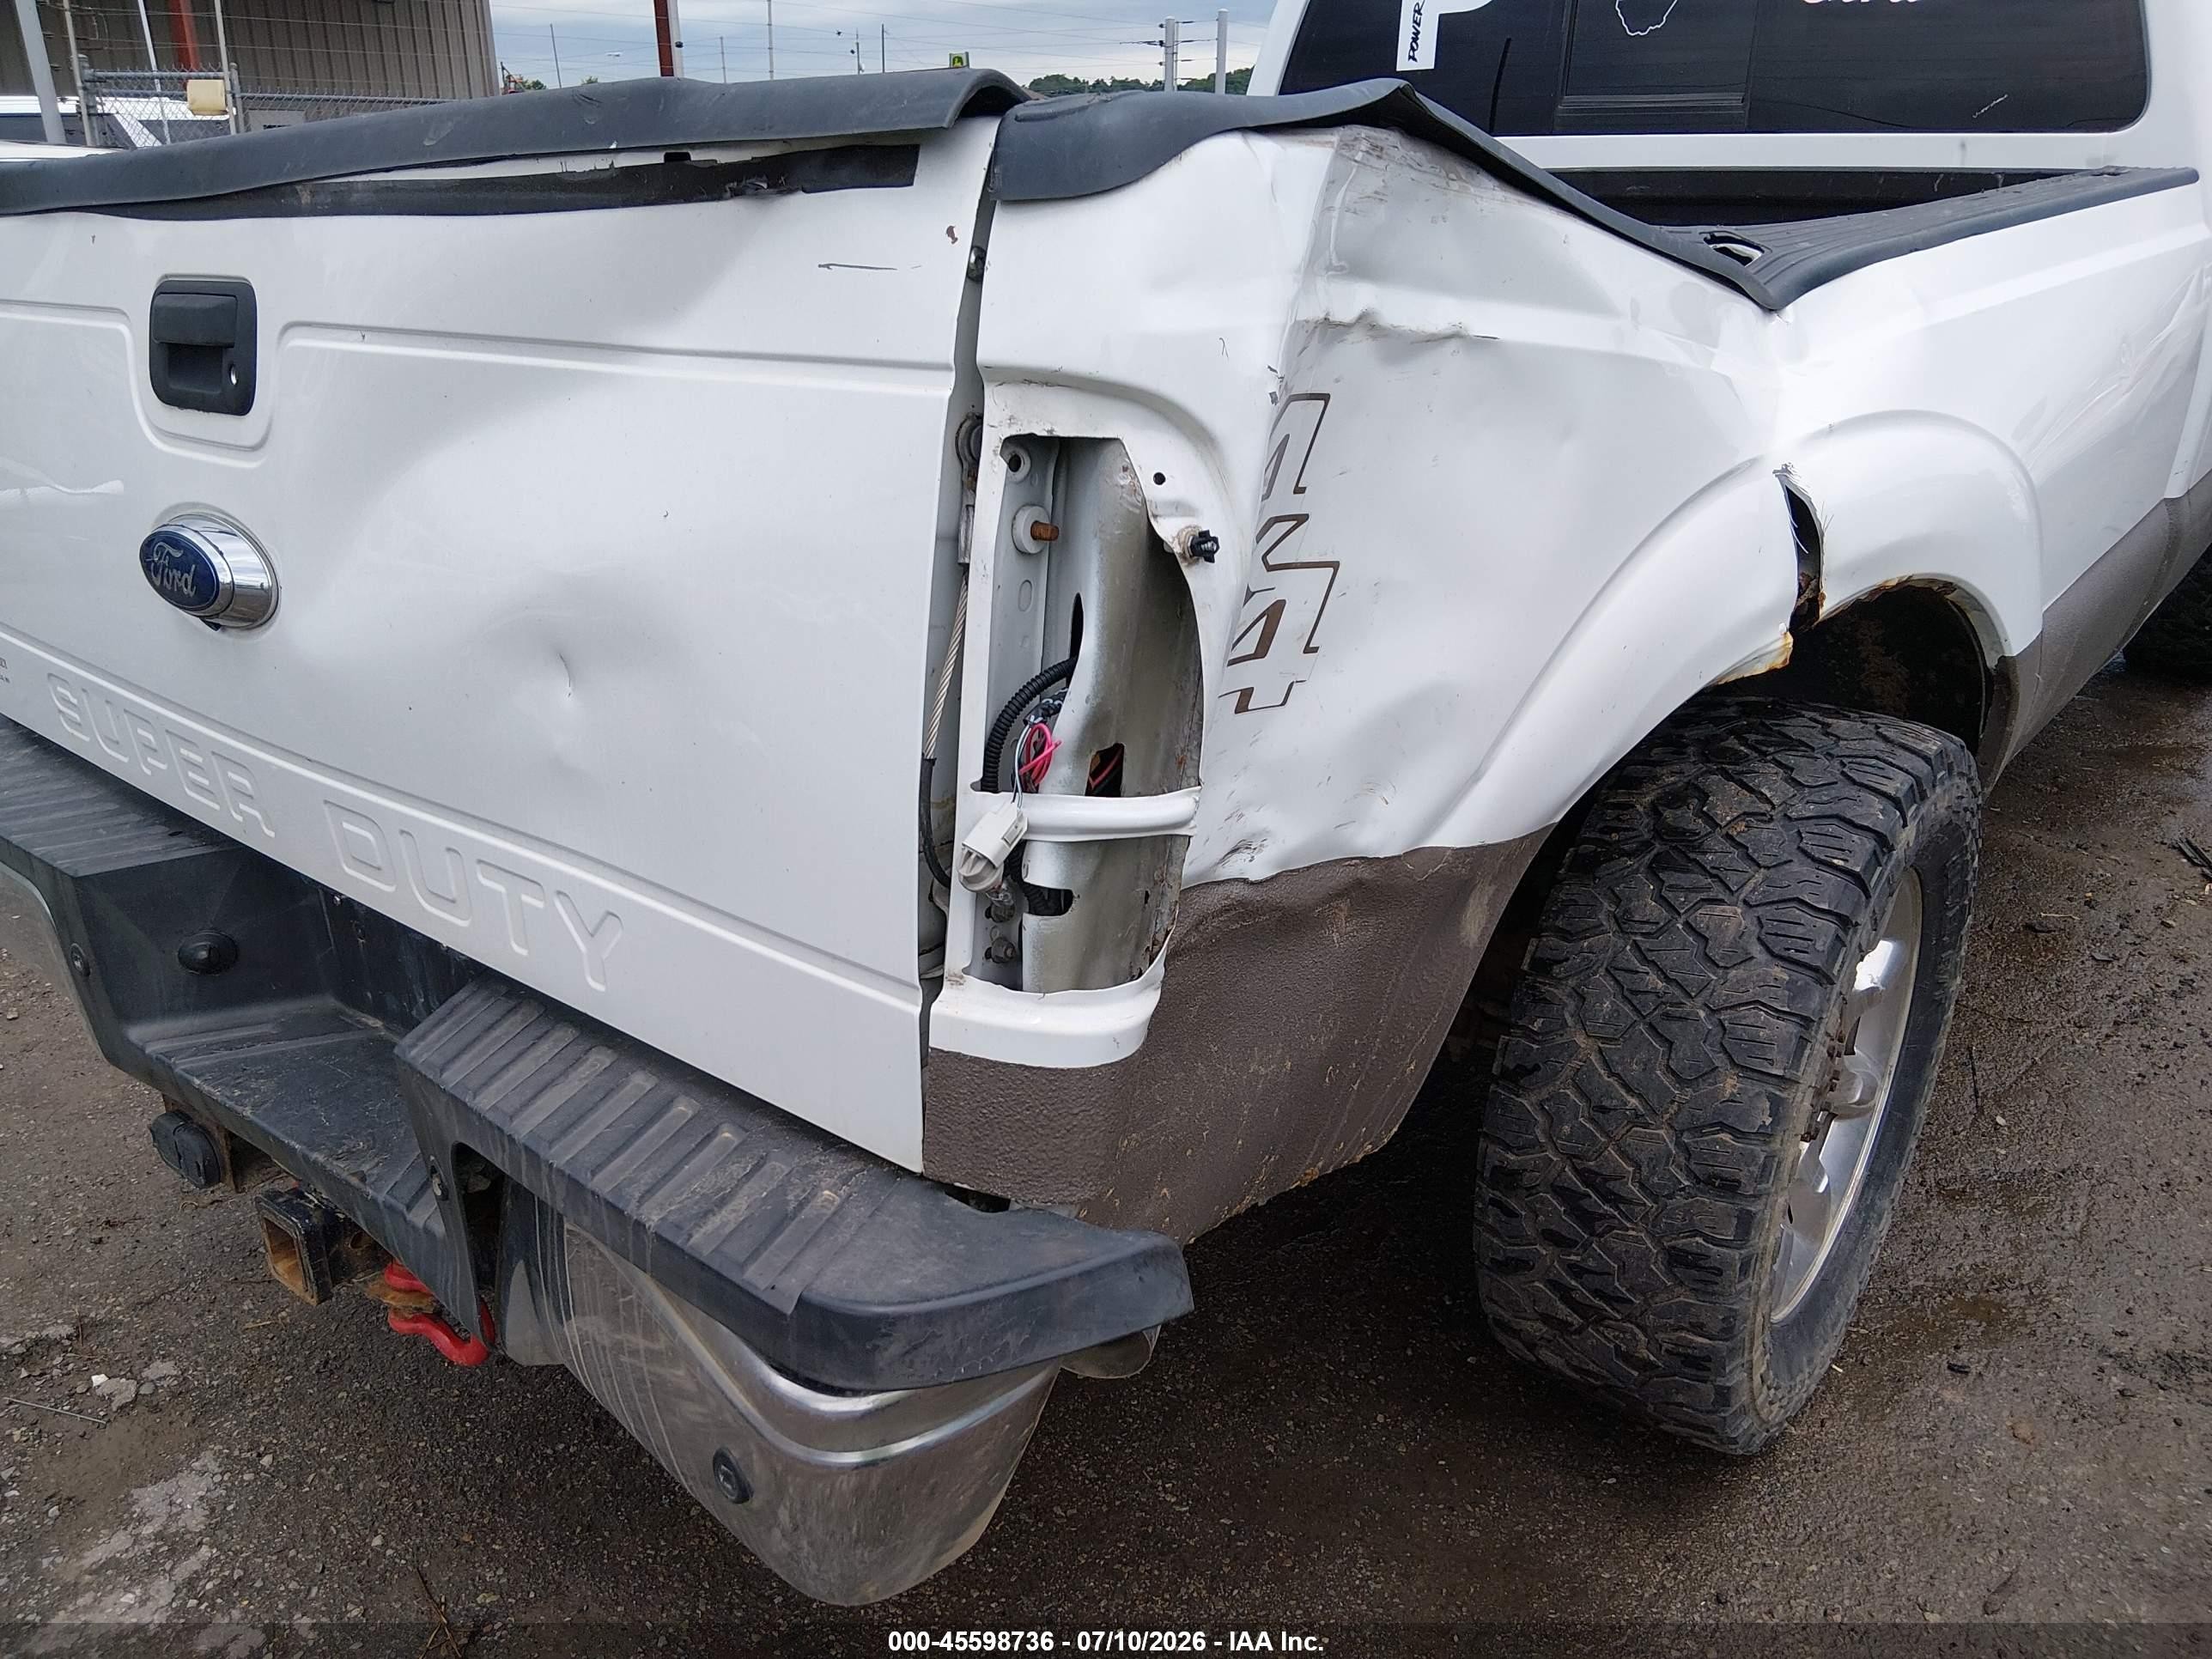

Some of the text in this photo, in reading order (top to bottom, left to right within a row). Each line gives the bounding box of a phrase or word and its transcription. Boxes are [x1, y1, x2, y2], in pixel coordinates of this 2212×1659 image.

[1407, 0, 1425, 62] POWER
[144, 541, 198, 599] Ford
[48, 672, 624, 993] SUPER DUTY
